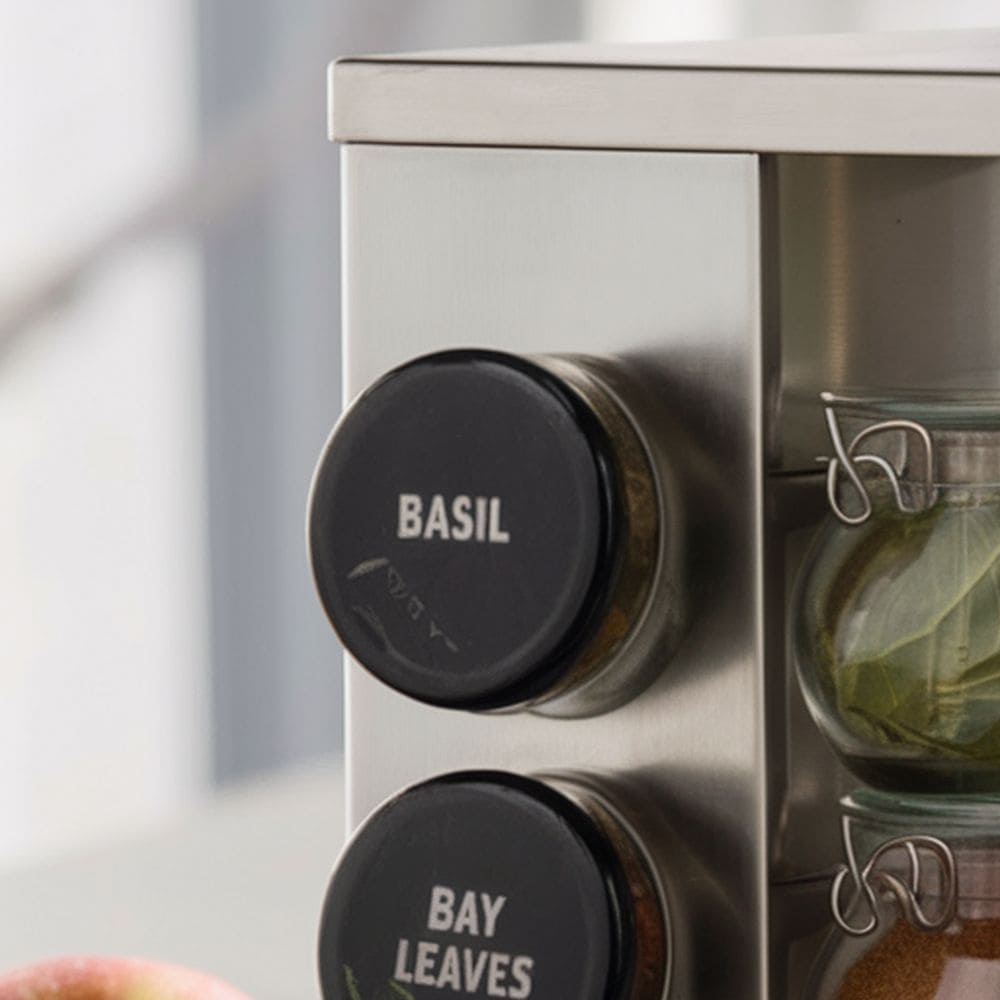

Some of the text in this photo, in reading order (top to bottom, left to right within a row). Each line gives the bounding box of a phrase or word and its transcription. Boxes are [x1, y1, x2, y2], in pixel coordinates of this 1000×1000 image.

[397, 493, 510, 542] BASIL
[428, 885, 506, 938] BAY
[394, 937, 533, 1000] LEAVES
